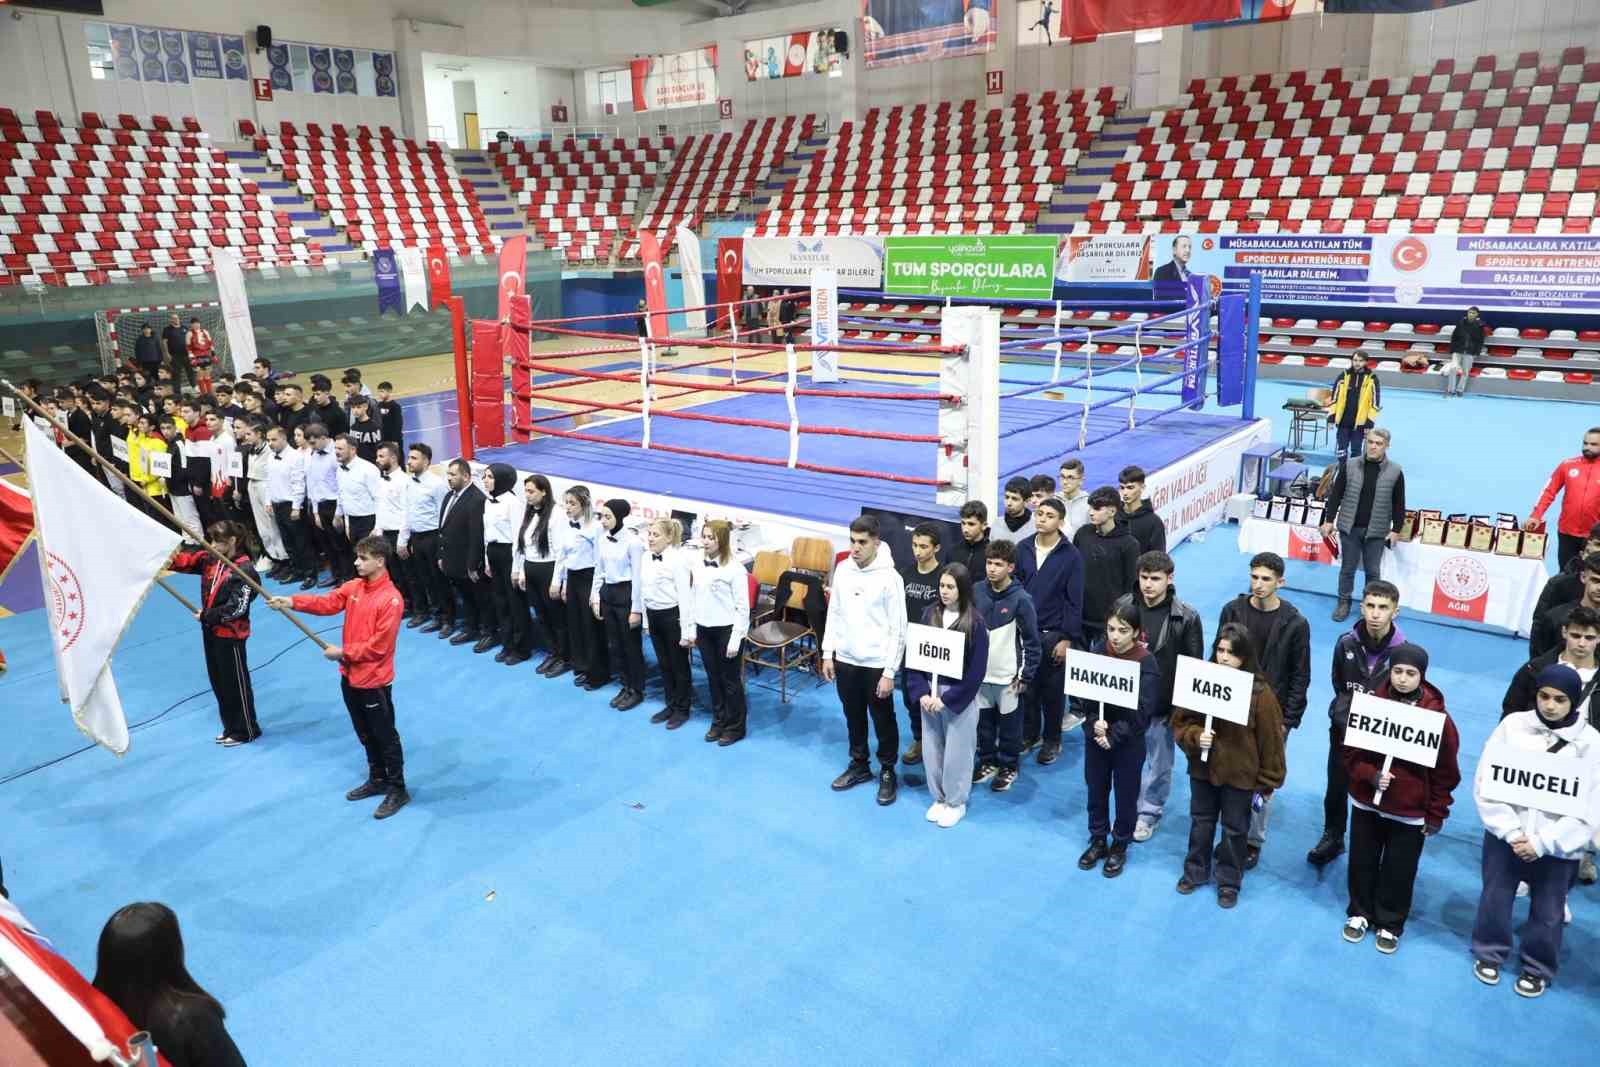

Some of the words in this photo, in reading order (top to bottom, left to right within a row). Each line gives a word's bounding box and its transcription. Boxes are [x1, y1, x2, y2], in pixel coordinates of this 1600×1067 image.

[259, 80, 267, 95] F
[989, 72, 1000, 89] H
[722, 101, 730, 115] G
[1229, 239, 1298, 249] MÜSABAKALARA
[1301, 240, 1342, 249] KATILAN
[1343, 239, 1363, 249] TÜM
[1468, 239, 1558, 250] MÜSABAKALARA
[1242, 255, 1276, 264] SPORCU
[1278, 255, 1290, 264] VE
[1291, 255, 1364, 265] ANTRENÖRLERE
[1485, 257, 1528, 267] SPORCU
[1529, 257, 1544, 267] VE
[892, 261, 927, 276] TÜM
[930, 262, 1047, 278] SPORCULARA
[1494, 273, 1555, 284] BAŞARILAR
[1153, 485, 1169, 511] ĞRI
[1448, 600, 1470, 612] AĞRI
[919, 641, 951, 661] IĞDIR
[1070, 667, 1134, 693] HAKKARİ
[1192, 678, 1233, 701] KARS
[1348, 713, 1440, 749] ERZİNCAN
[1490, 764, 1580, 797] TUNCELİ
